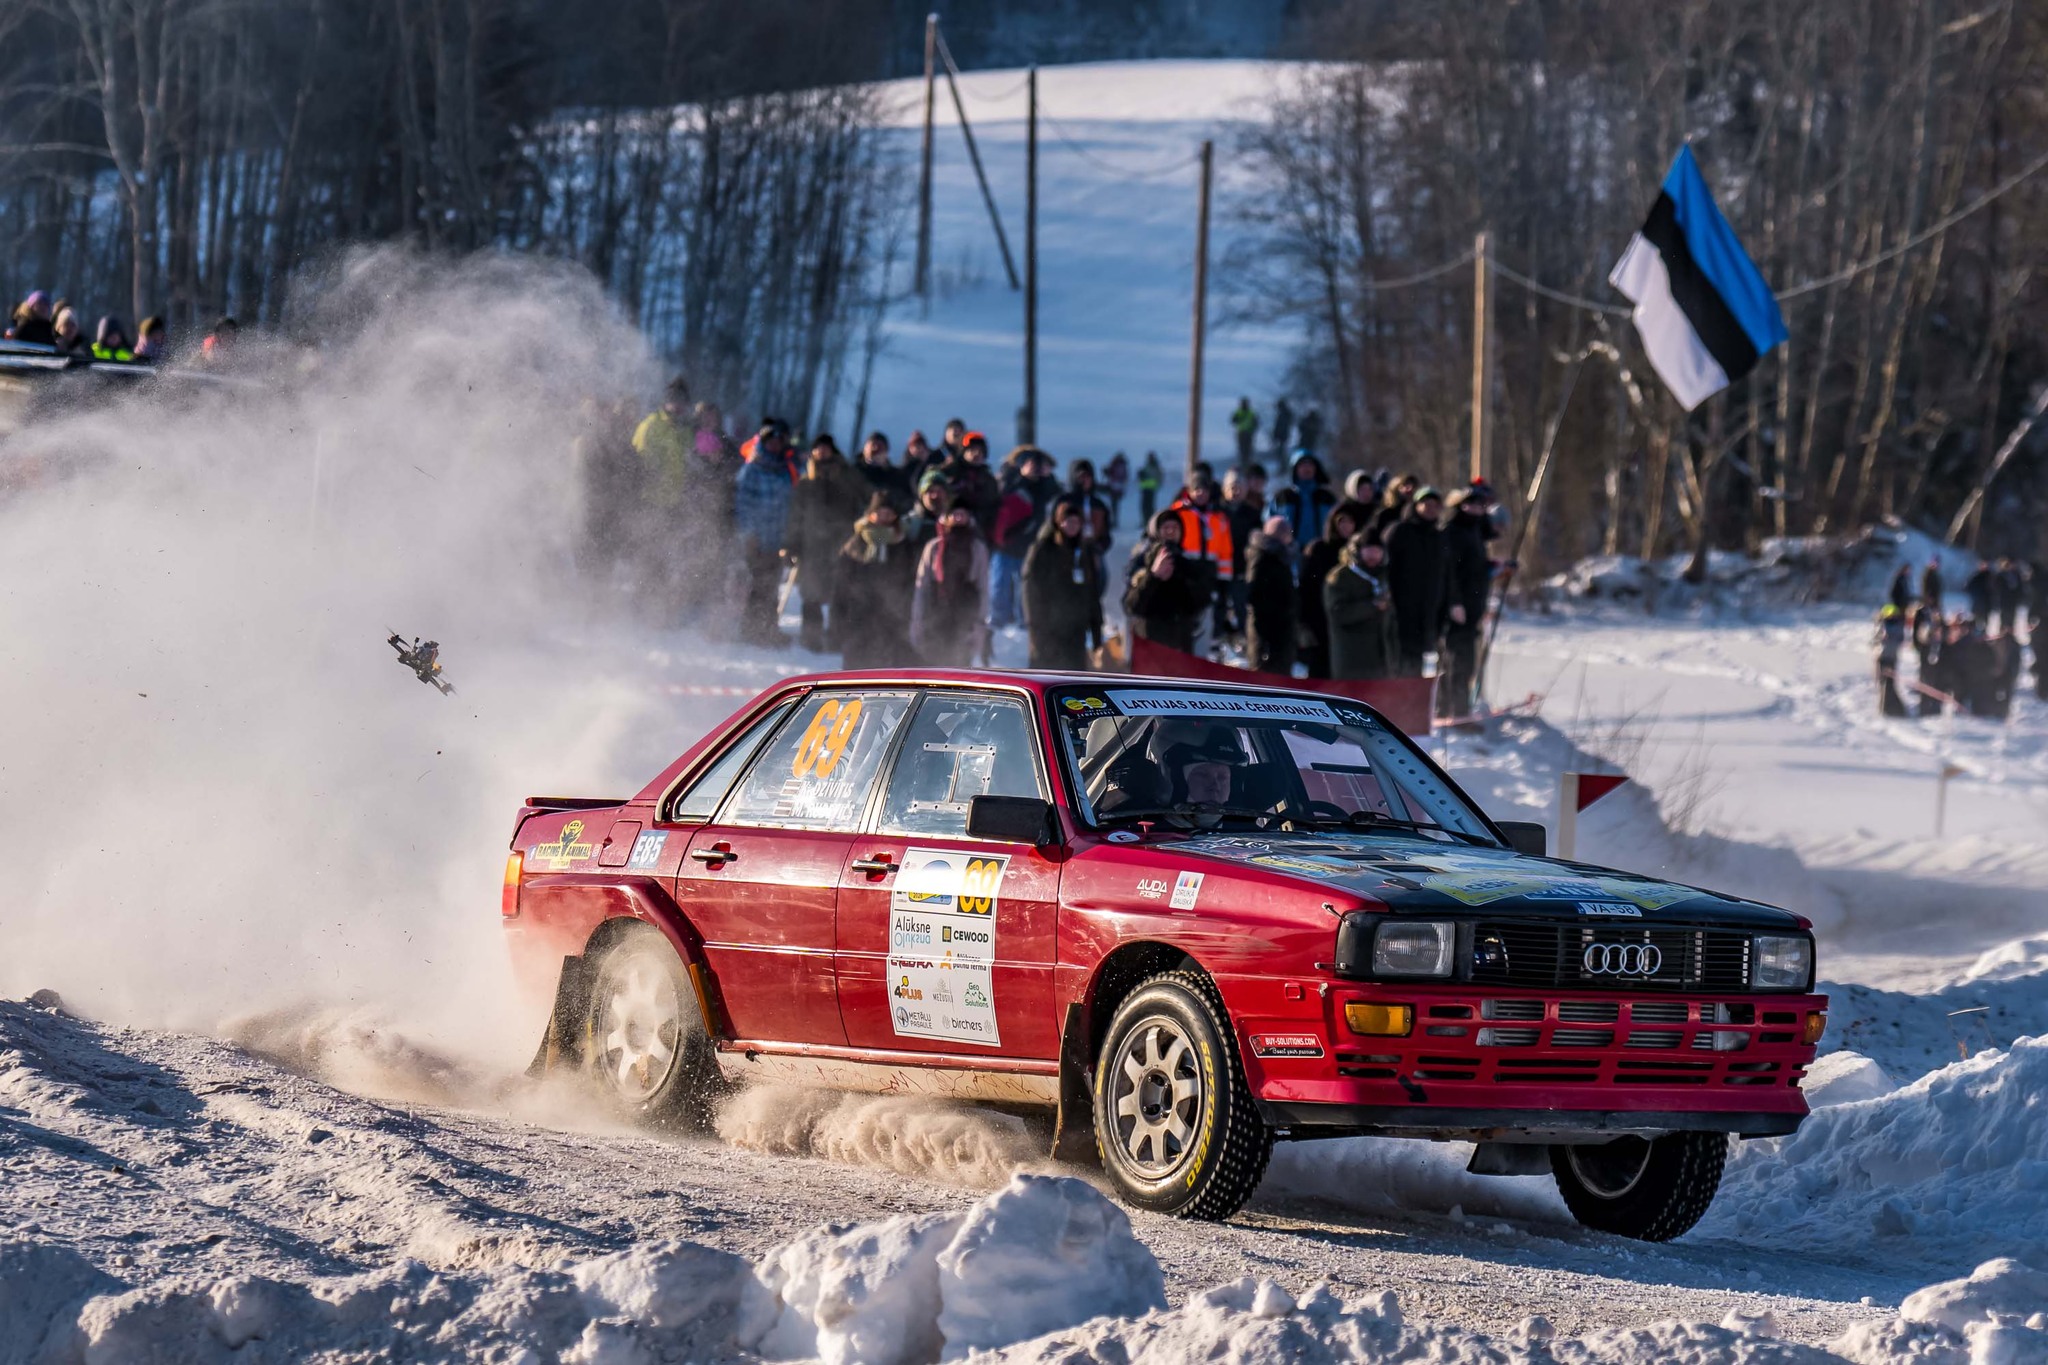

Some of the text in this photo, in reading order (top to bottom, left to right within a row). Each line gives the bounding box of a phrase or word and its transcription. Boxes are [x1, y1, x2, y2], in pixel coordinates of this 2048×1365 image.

[1121, 700, 1330, 718] LATVIJAS RALLIJA ČEMPIONĀTS
[792, 699, 862, 779] 69
[631, 835, 665, 863] E85
[960, 859, 998, 914] 69
[1136, 878, 1167, 893] AUDA
[1590, 902, 1635, 915] VA-58
[895, 916, 931, 934] Alūksne
[953, 930, 989, 943] CEWOOD
[894, 985, 922, 1000] 4PLUS
[969, 982, 979, 991] Geo
[964, 999, 989, 1008] Solutions
[951, 1017, 983, 1031] birchers
[1264, 1037, 1316, 1045] BUY-SOLUTIONS.COM
